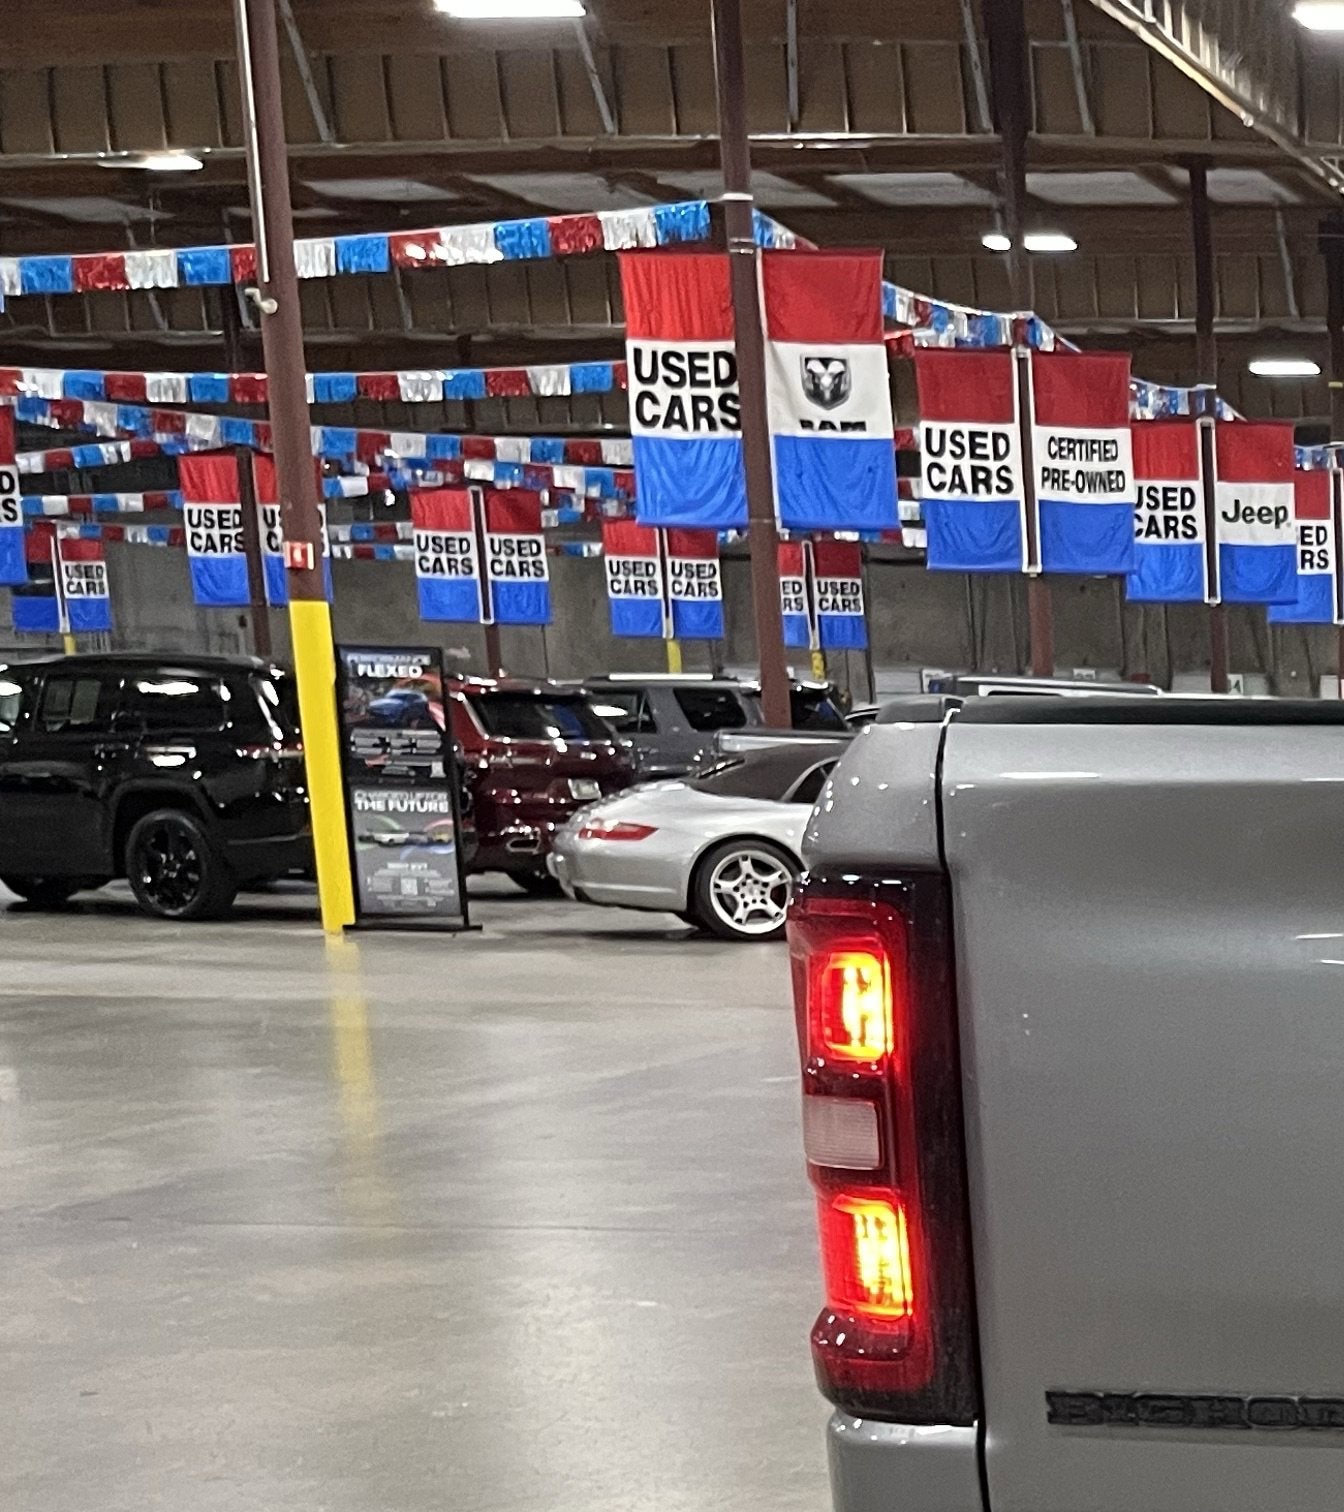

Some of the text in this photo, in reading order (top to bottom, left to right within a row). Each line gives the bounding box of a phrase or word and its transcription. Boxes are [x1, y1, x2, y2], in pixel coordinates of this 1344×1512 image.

[633, 347, 736, 389] USED
[635, 390, 741, 432] CARS
[925, 427, 1011, 462] USED
[1047, 436, 1119, 462] CERTIFIED
[926, 461, 1014, 495] CARS
[1041, 467, 1126, 493] PRE-OWNED
[187, 507, 243, 529] USED
[1222, 499, 1288, 529] Jeep
[190, 531, 244, 553] CARS
[416, 534, 471, 555] USED
[1300, 525, 1328, 546] ED
[490, 537, 542, 558] USED
[418, 556, 474, 576] CARS
[490, 559, 546, 578] CARS
[609, 560, 656, 578] USED
[1300, 548, 1329, 570] RS
[65, 564, 104, 580] USED
[671, 561, 717, 580] USED
[66, 580, 105, 595] CARS
[610, 579, 659, 596] CARS
[671, 580, 719, 598] CARS
[782, 580, 802, 595] ED
[817, 580, 860, 595] USED
[783, 597, 804, 612] RS
[818, 597, 862, 612] CARS
